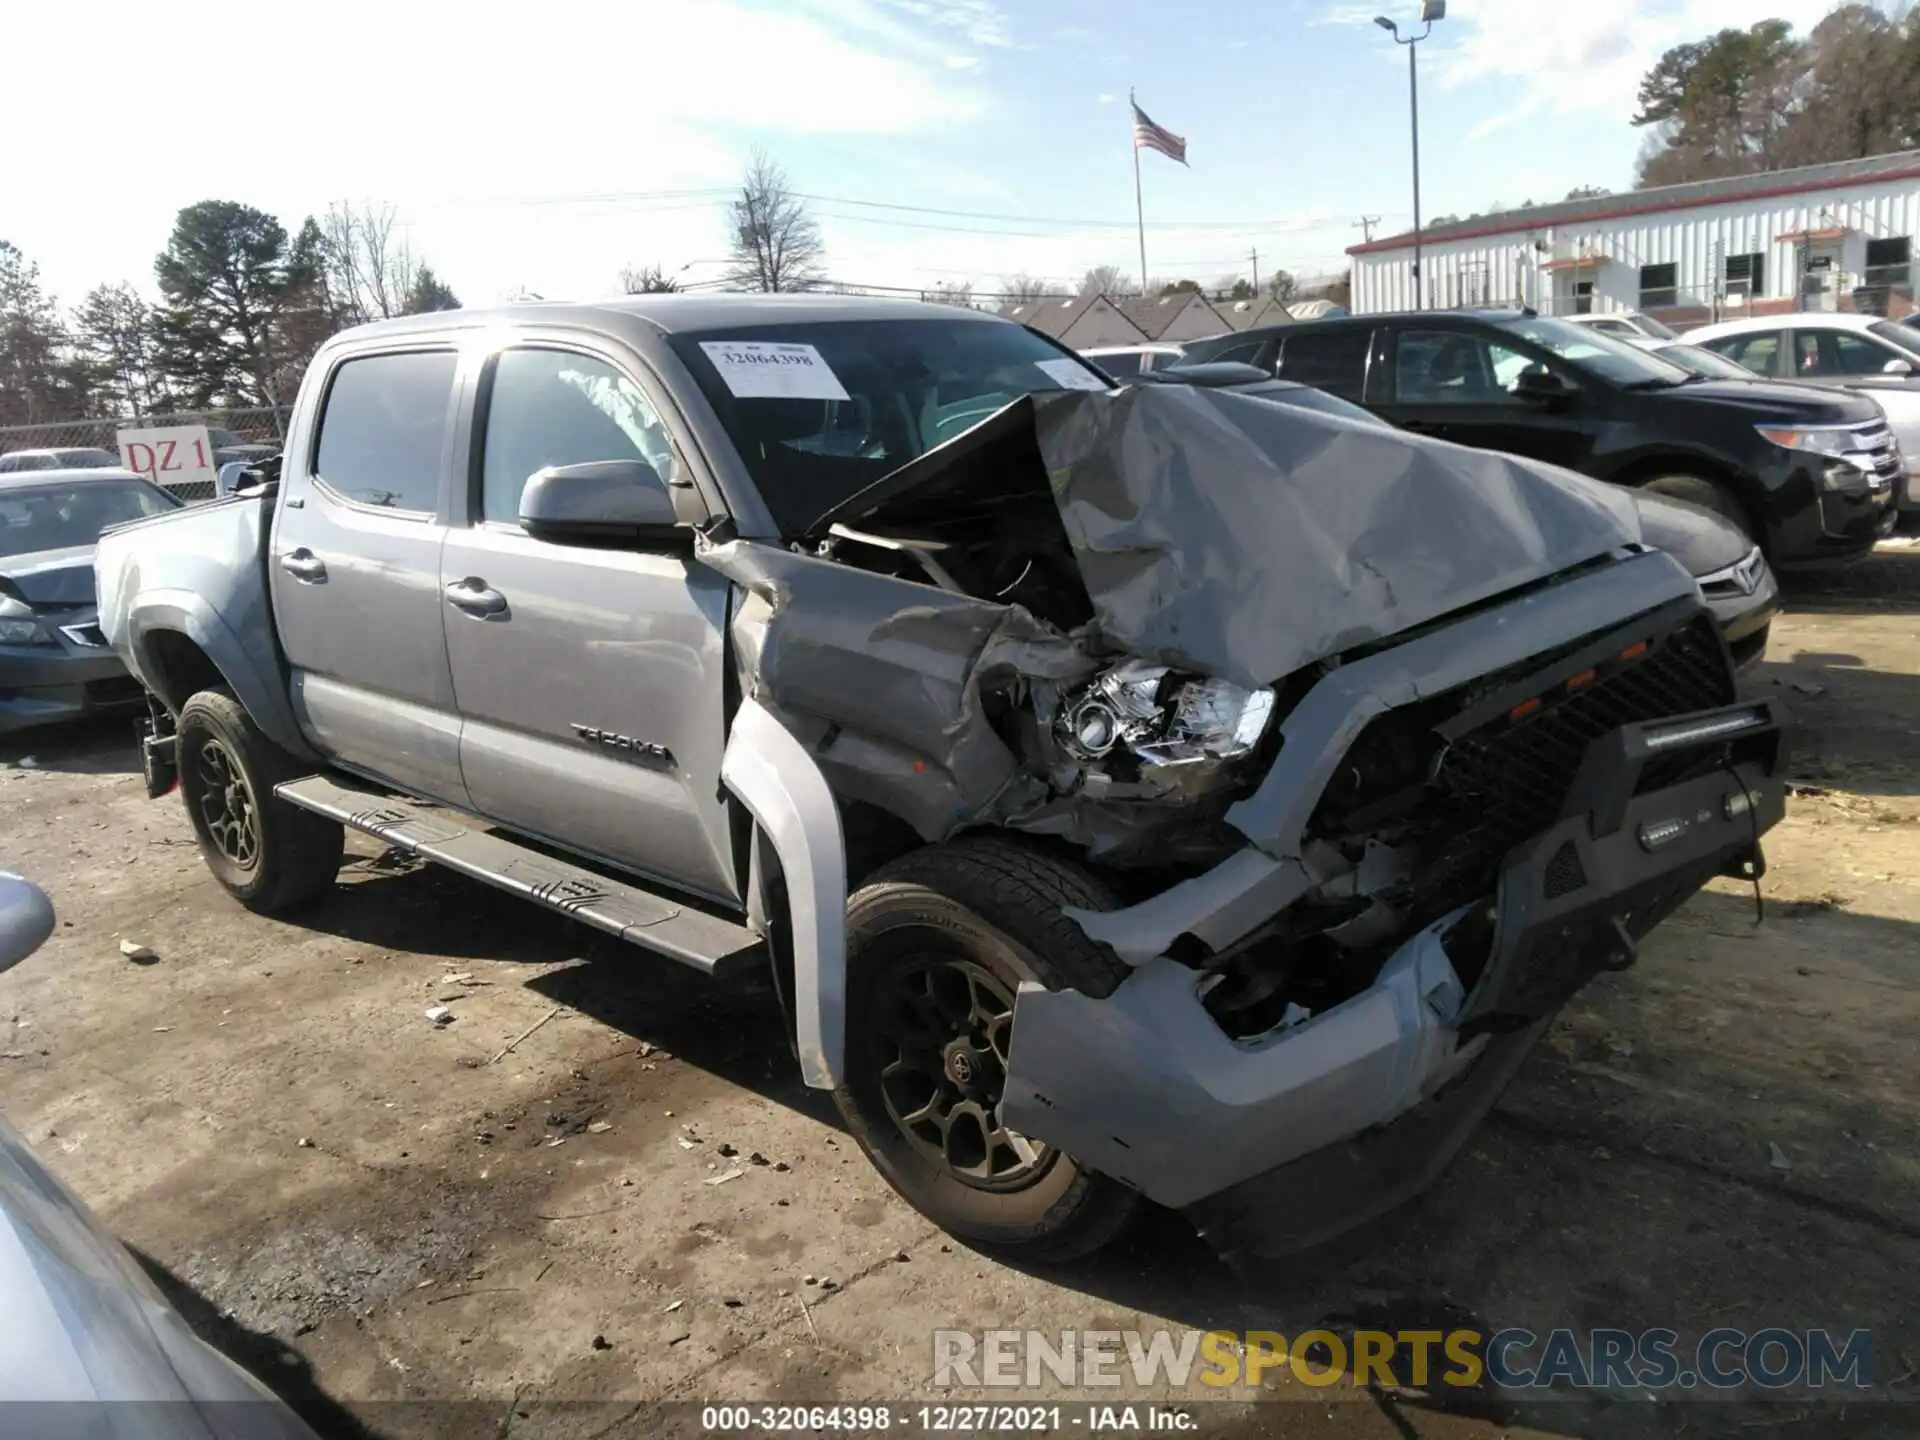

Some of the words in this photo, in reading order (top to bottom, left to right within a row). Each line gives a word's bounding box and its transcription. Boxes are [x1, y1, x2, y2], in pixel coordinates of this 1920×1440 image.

[722, 352, 814, 367] 32064398
[125, 440, 182, 474] DZ
[569, 722, 679, 769] TACOMA
